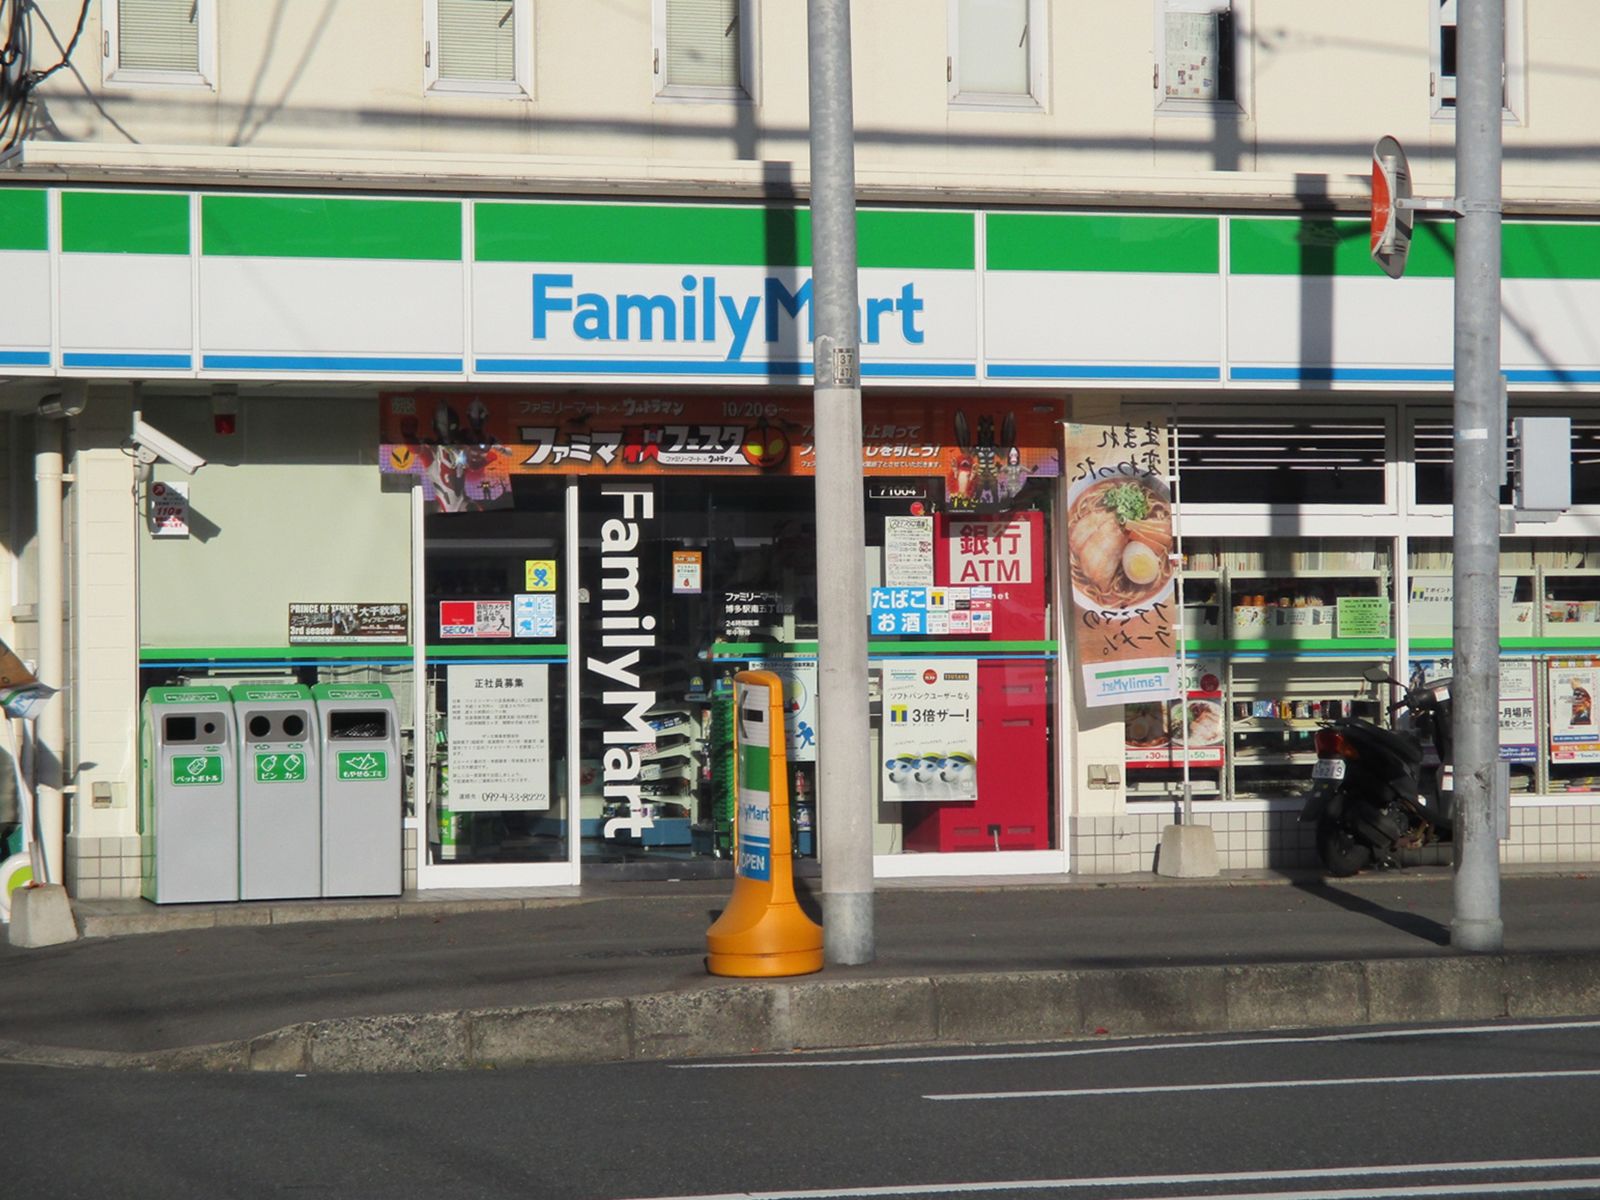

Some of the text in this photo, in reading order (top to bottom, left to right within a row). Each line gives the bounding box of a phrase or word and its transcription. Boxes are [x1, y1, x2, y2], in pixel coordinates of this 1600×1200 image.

[532, 273, 925, 362] FamilyMrt
[840, 354, 853, 365] 37
[959, 524, 1022, 556] 銀行
[959, 559, 1021, 582] ATM
[872, 590, 926, 610] たばこ
[442, 625, 474, 635] SECOM
[877, 612, 921, 633] お酒
[587, 484, 657, 840] FamilyMart
[474, 678, 524, 689] 正社員募集
[176, 774, 219, 783] ペットボトル
